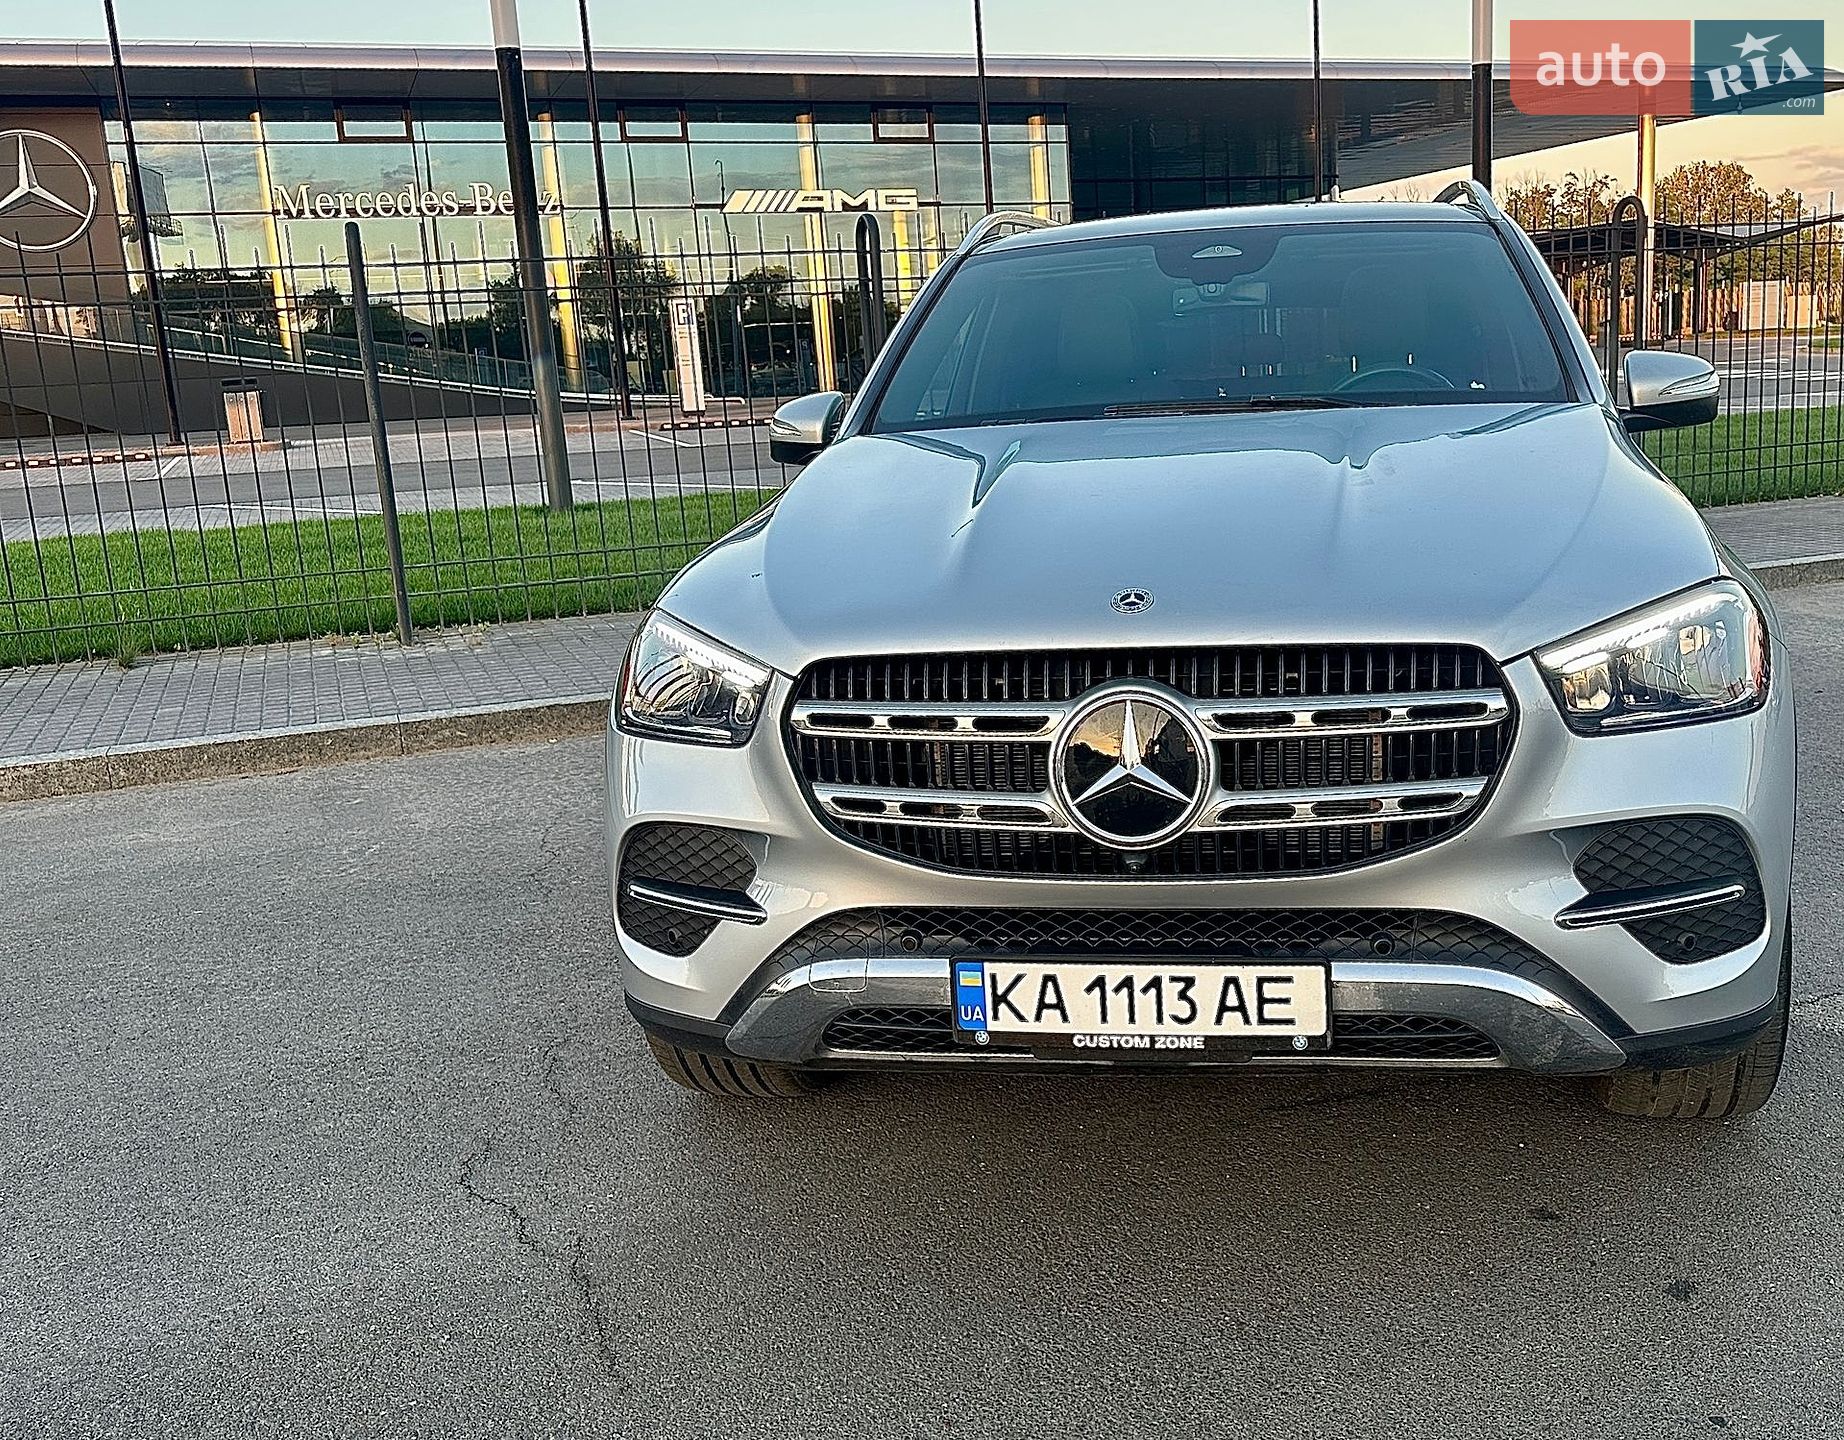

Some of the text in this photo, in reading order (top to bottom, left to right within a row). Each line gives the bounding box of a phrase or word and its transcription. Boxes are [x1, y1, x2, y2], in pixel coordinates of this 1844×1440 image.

[274, 182, 562, 219] Mercedes-Bez
[786, 189, 919, 212] AMG
[989, 972, 1297, 1026] KA 1113 AE
[960, 1005, 984, 1022] UA
[1072, 1034, 1205, 1049] CUSTOM ZONE
